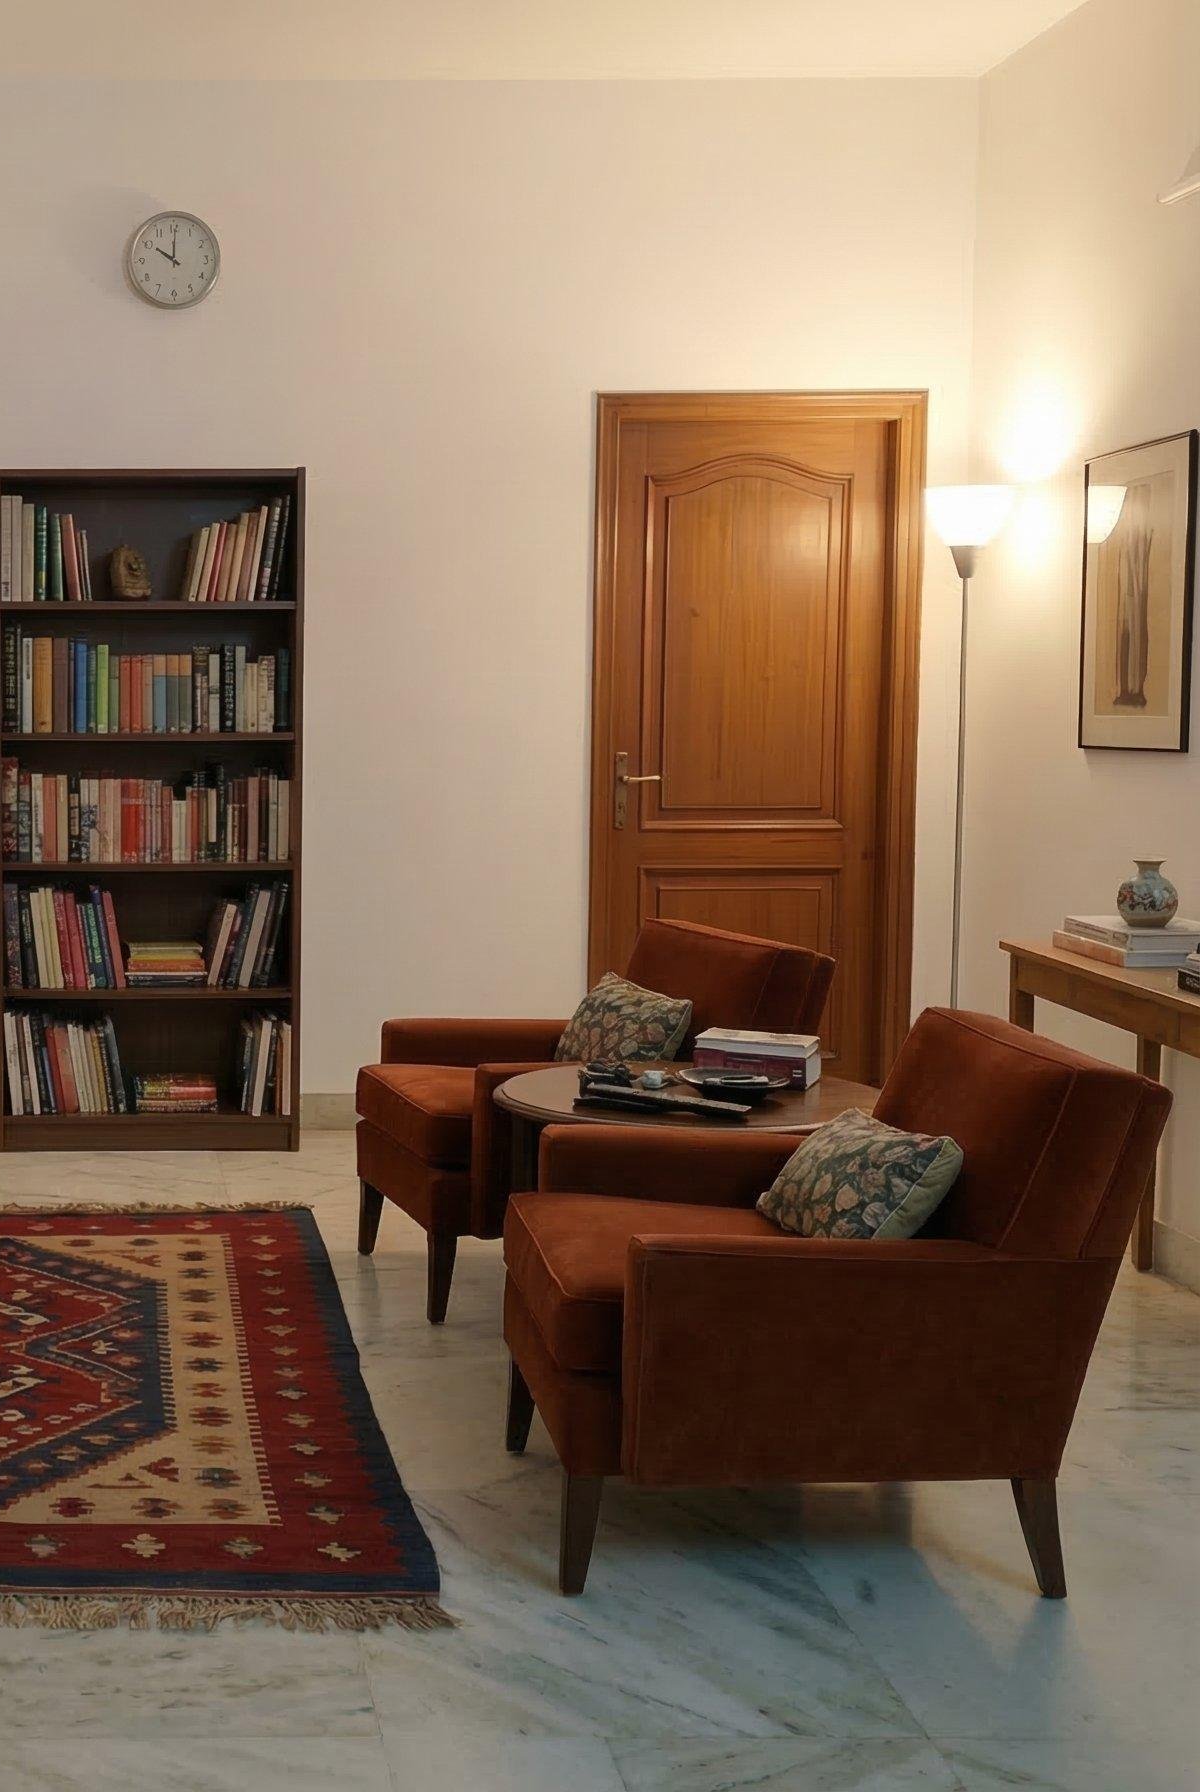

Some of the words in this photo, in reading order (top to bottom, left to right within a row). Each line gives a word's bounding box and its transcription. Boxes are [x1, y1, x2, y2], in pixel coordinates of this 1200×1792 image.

[203, 255, 209, 264] 3
[156, 284, 161, 296] 7
[188, 283, 193, 293] 5
